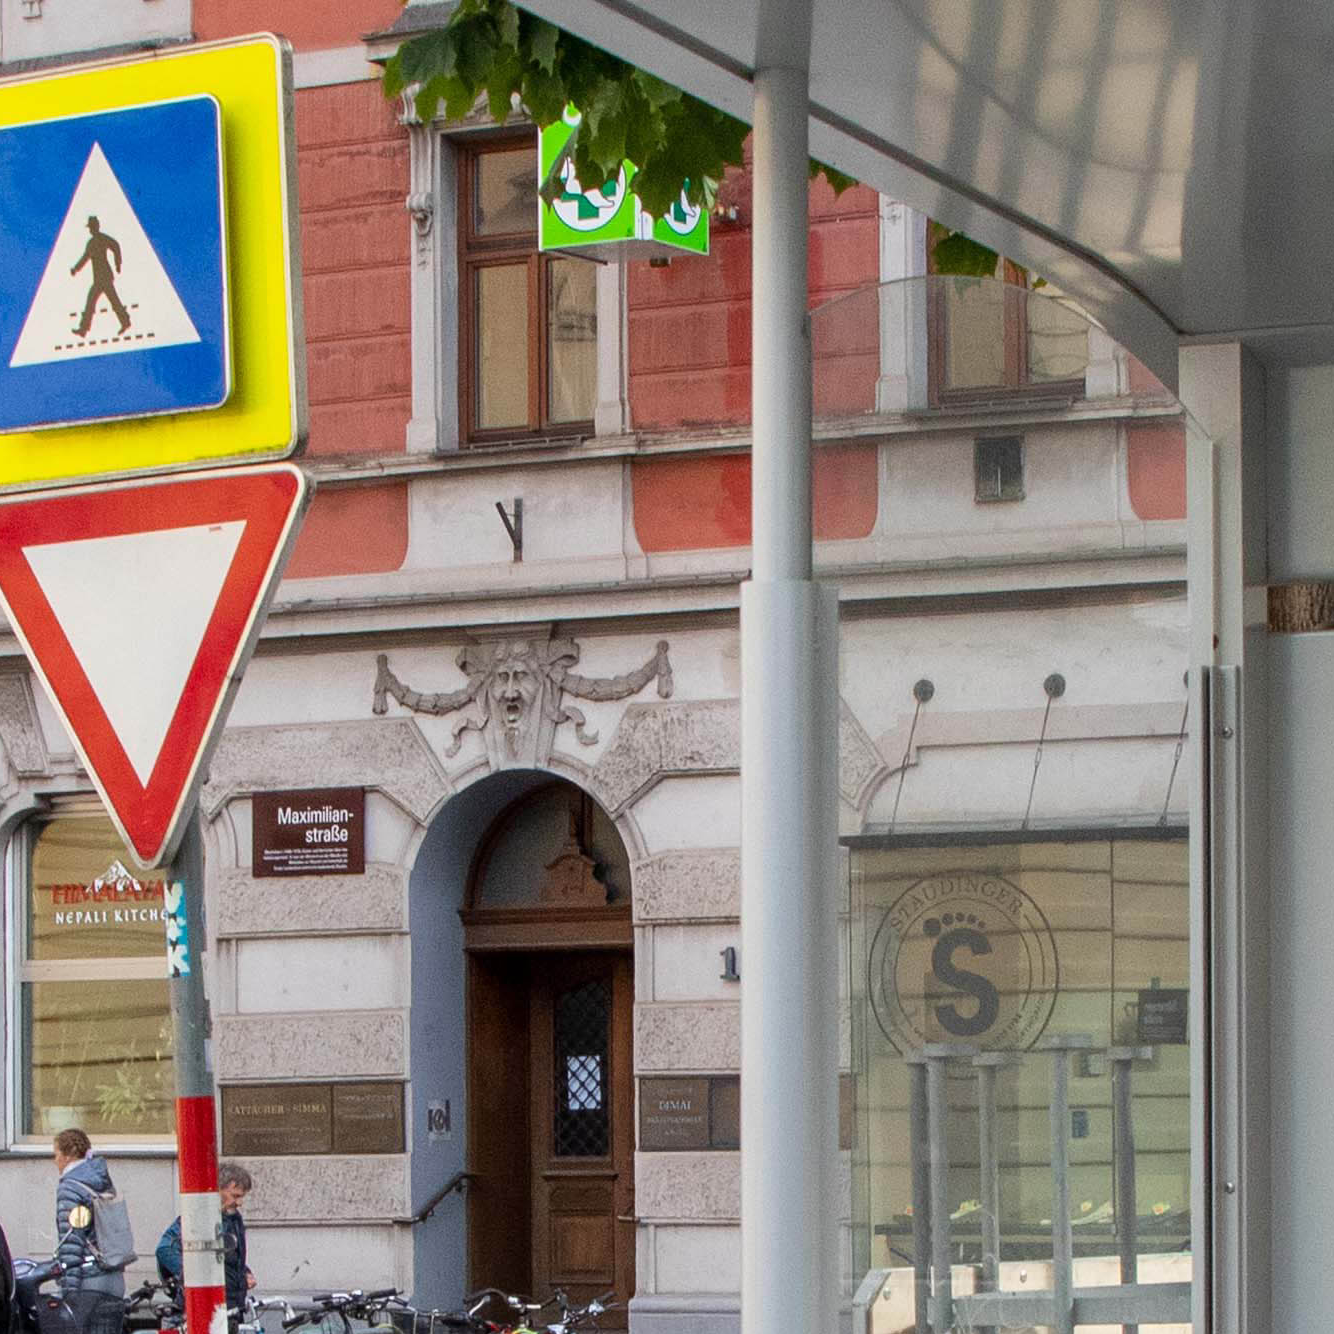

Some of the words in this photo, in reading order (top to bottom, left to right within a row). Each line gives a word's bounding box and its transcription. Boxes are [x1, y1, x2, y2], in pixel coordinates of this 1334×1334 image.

[277, 805, 354, 825] Maximilian-
[305, 824, 348, 843] straße
[890, 876, 1023, 928] STAUDINGER
[55, 910, 107, 925] NEPALI
[114, 907, 168, 923] KITCHE
